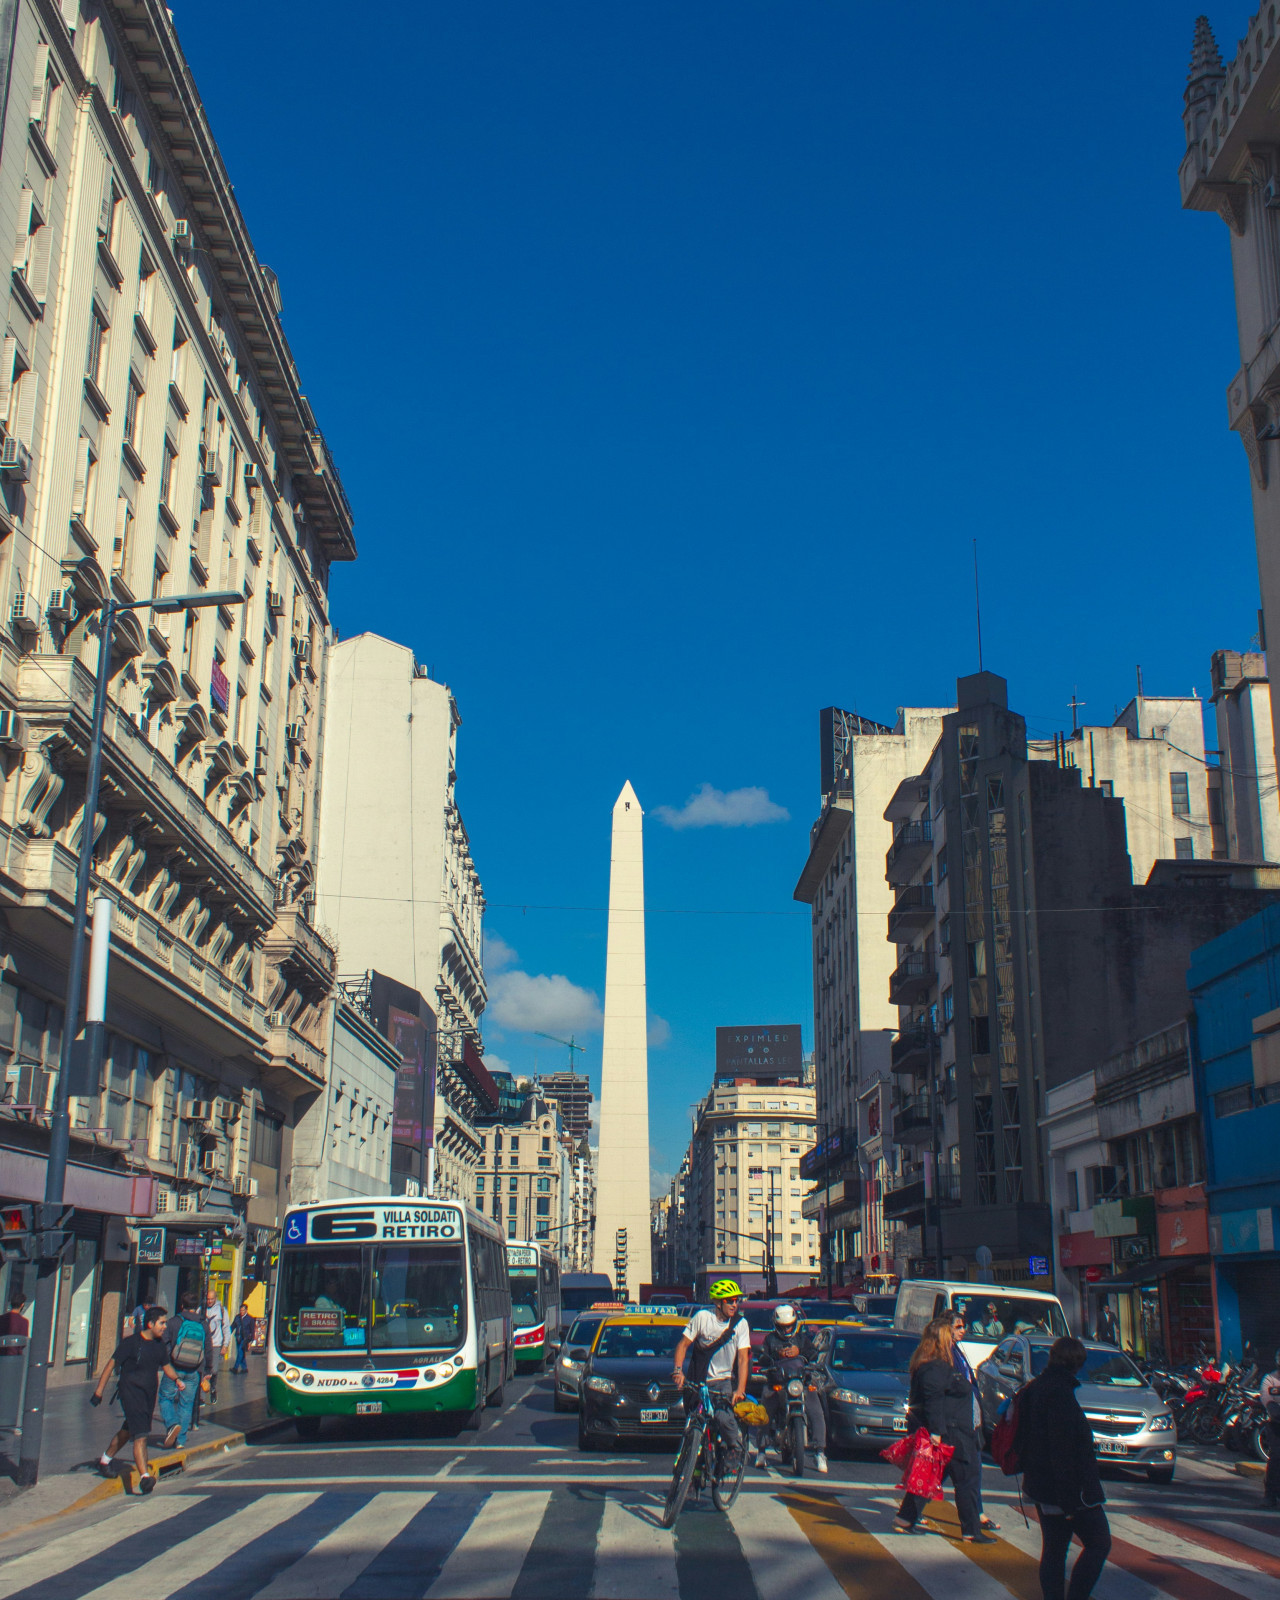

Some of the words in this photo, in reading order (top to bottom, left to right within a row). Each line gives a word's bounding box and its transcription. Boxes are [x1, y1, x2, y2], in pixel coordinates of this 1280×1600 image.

[383, 1211, 411, 1223] VILLA
[413, 1211, 456, 1223] SOLDATI
[312, 1212, 377, 1241] 6
[383, 1226, 455, 1238] RETIRO
[317, 1378, 348, 1387] NUDO
[376, 1376, 394, 1384] 4284
